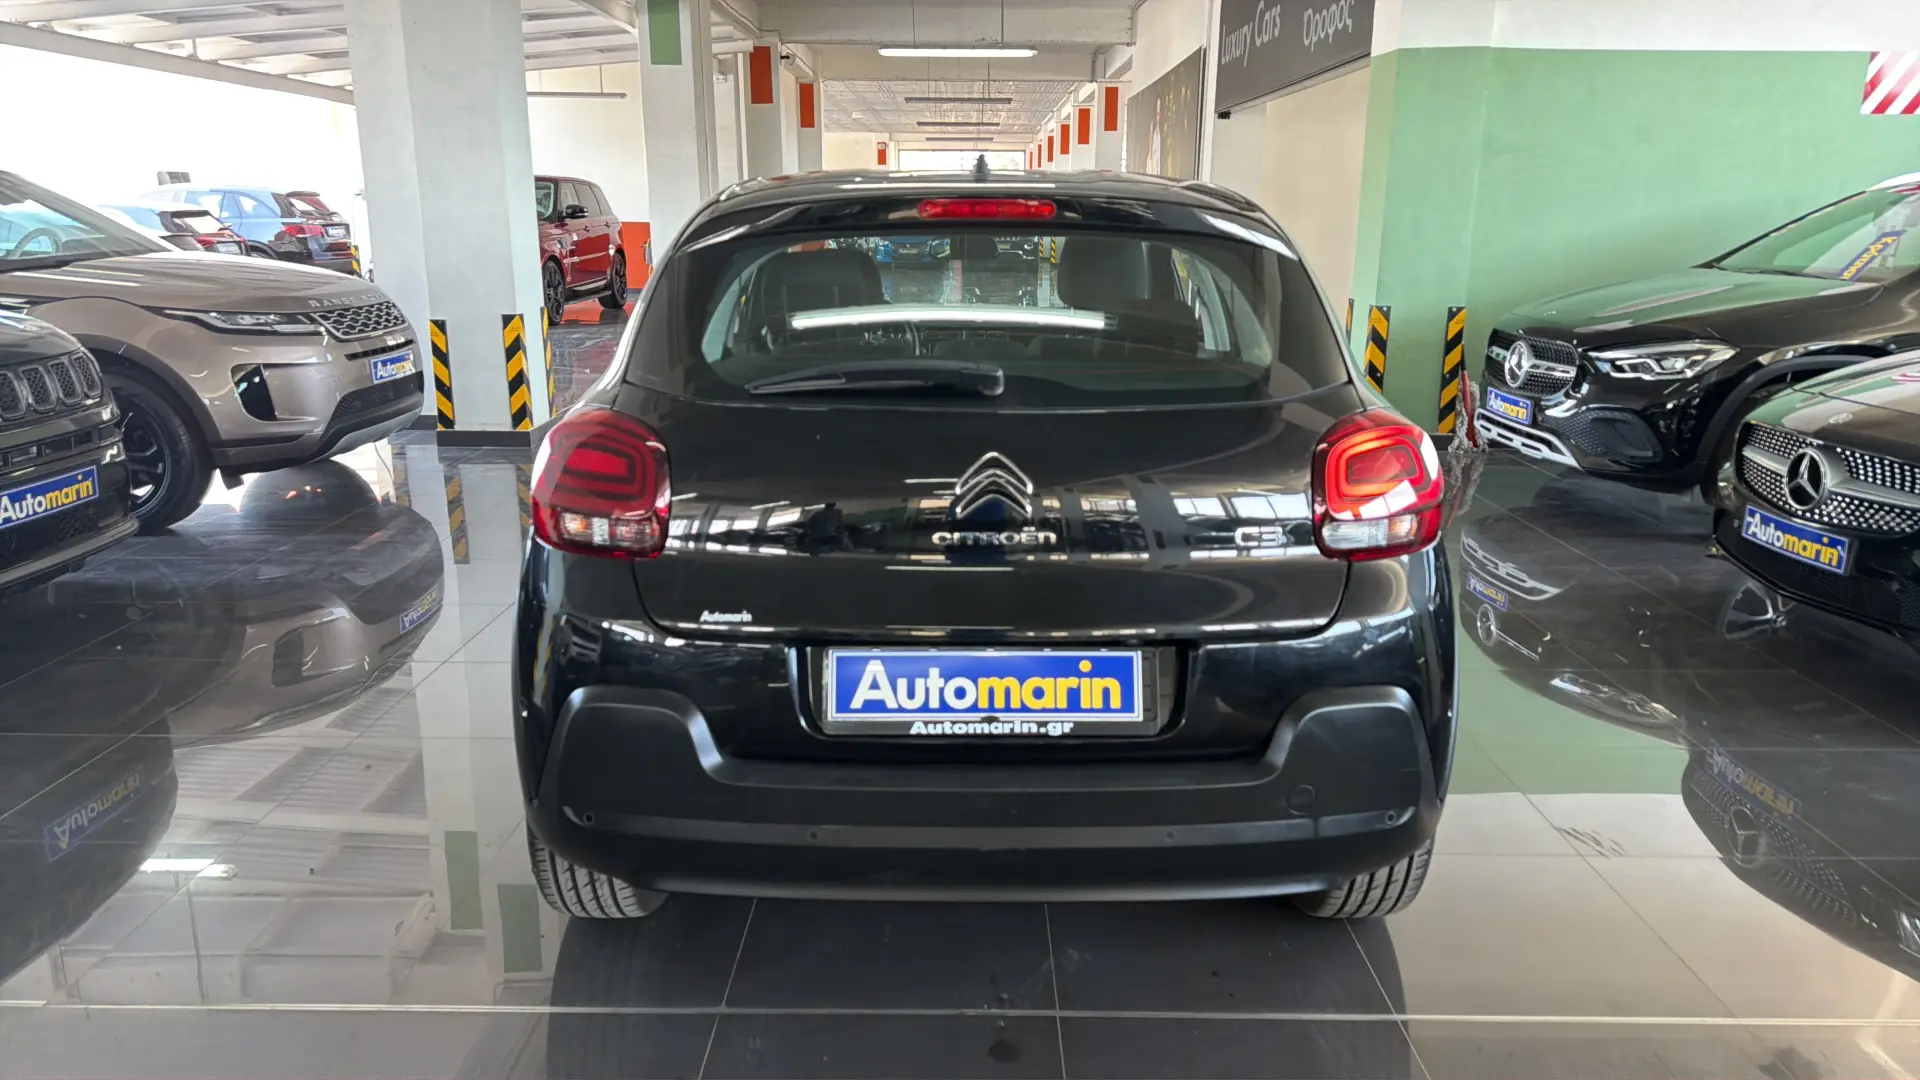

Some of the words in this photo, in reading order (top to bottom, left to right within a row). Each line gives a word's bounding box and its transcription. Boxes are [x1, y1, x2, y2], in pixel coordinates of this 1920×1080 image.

[1221, 25, 1253, 67] Luxury
[1254, 0, 1281, 47] Cars
[308, 296, 358, 307] RANGE
[0, 474, 94, 524] Automarin
[1234, 526, 1284, 547] C3
[1748, 512, 1839, 567] Automarin
[699, 609, 753, 622] Automarin
[849, 659, 1122, 710] Automarin
[909, 719, 1075, 736] Automarin.gr
